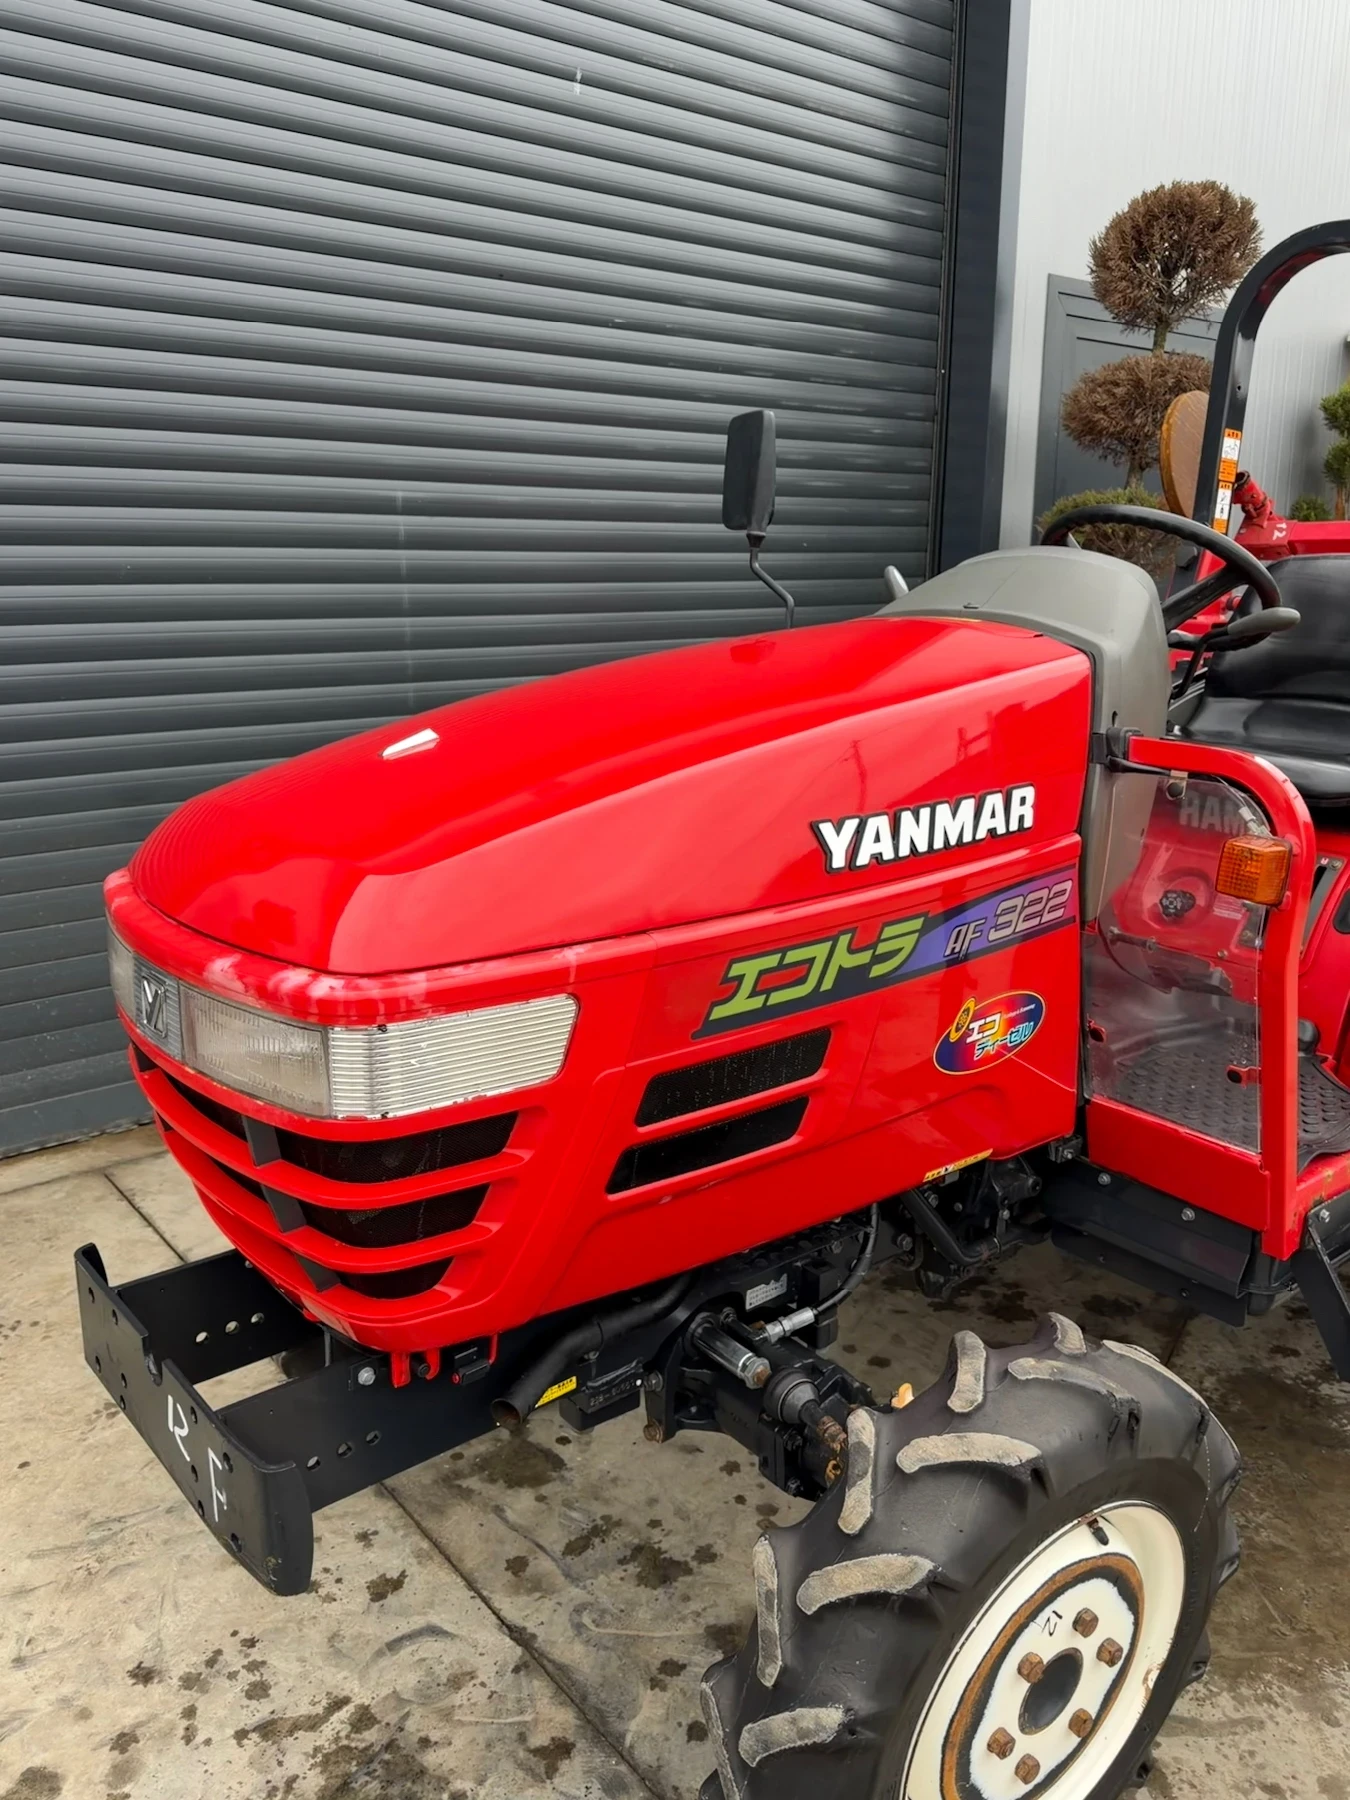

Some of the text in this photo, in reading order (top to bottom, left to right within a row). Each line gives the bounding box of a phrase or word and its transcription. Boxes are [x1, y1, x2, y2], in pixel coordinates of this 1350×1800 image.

[812, 783, 1036, 872] YANMAR
[709, 916, 924, 1021] エコトラ
[944, 918, 986, 961] AF
[988, 879, 1074, 943] 322
[966, 1012, 1002, 1044] エコ
[974, 1021, 1034, 1061] ディーゼル
